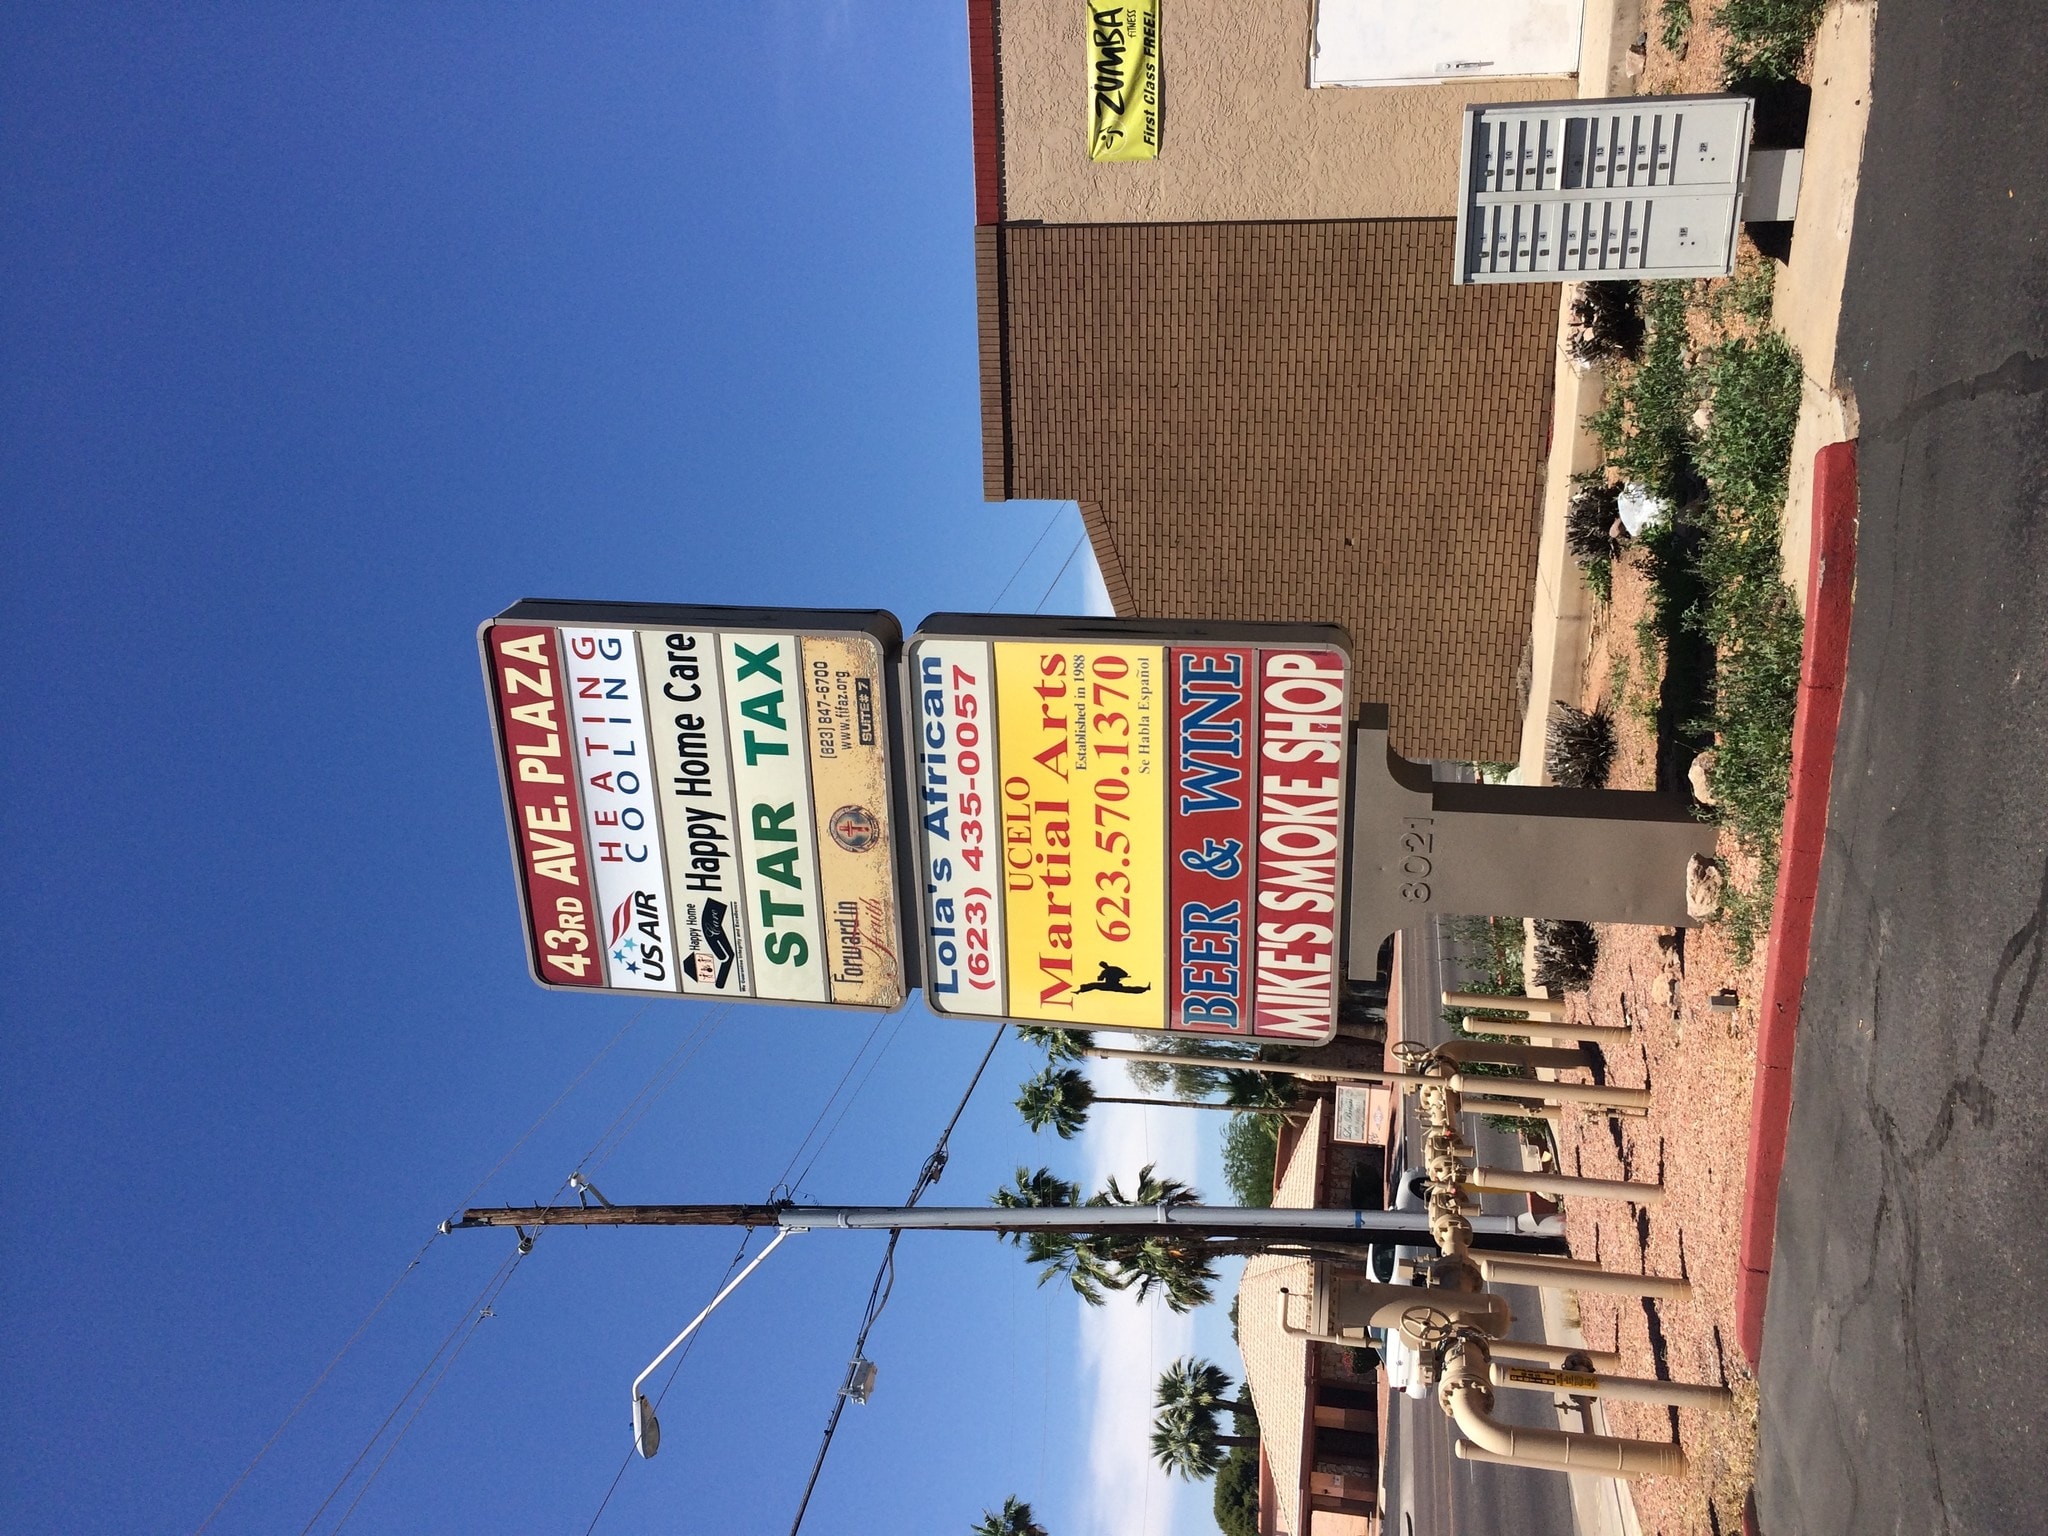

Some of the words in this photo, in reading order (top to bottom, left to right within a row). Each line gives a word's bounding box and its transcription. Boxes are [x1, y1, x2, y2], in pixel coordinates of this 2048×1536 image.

[1094, 8, 1126, 118] ZUMBA
[1144, 11, 1156, 58] FREE!
[1144, 62, 1156, 106] Class
[1144, 108, 1155, 146] First
[1506, 151, 1512, 160] 10
[1547, 150, 1552, 158] 12
[1598, 148, 1604, 156] 13
[1618, 147, 1624, 155] 14
[1639, 146, 1645, 154] 15
[1700, 143, 1706, 152] 2P
[664, 634, 701, 702] Care
[813, 661, 832, 724] 847-6700
[858, 682, 868, 690] 7
[1073, 654, 1085, 682] 1988
[1074, 687, 1086, 698] in
[1136, 658, 1152, 710] Español
[500, 634, 565, 784] PLAZA
[734, 642, 789, 766] TAX
[835, 671, 852, 750] www.fifaz.org
[1033, 653, 1070, 784] Arts
[1074, 703, 1087, 770] Established
[1138, 716, 1150, 754] Habla
[1180, 653, 1243, 816] WINE
[1262, 654, 1344, 763] SHOP
[571, 636, 623, 862] HEATING
[599, 637, 648, 863] COOLING
[674, 714, 712, 796] Home
[921, 657, 951, 841] African
[952, 664, 984, 871] 435-0057
[1138, 759, 1150, 774] Se
[1092, 655, 1131, 943] 623.570.1370
[525, 795, 580, 885] AVE.
[684, 807, 731, 892] Happy
[1004, 776, 1034, 892] UCELO
[1180, 838, 1243, 880] &
[1258, 776, 1339, 912] SMOKE
[1400, 818, 1434, 904] 8021
[634, 890, 661, 942] AIR
[686, 904, 697, 925] Home
[751, 802, 809, 968] STAR
[834, 902, 858, 914] in
[1035, 800, 1074, 1011] Martial
[544, 896, 592, 977] 43RD
[689, 928, 702, 951] Happy
[705, 909, 720, 937] Care
[834, 919, 864, 984] Forward
[928, 857, 959, 994] Lola's
[964, 887, 996, 991] (623)
[642, 944, 665, 982] US
[1180, 899, 1241, 1029] BEER
[1257, 922, 1334, 1037] MIKE'S
